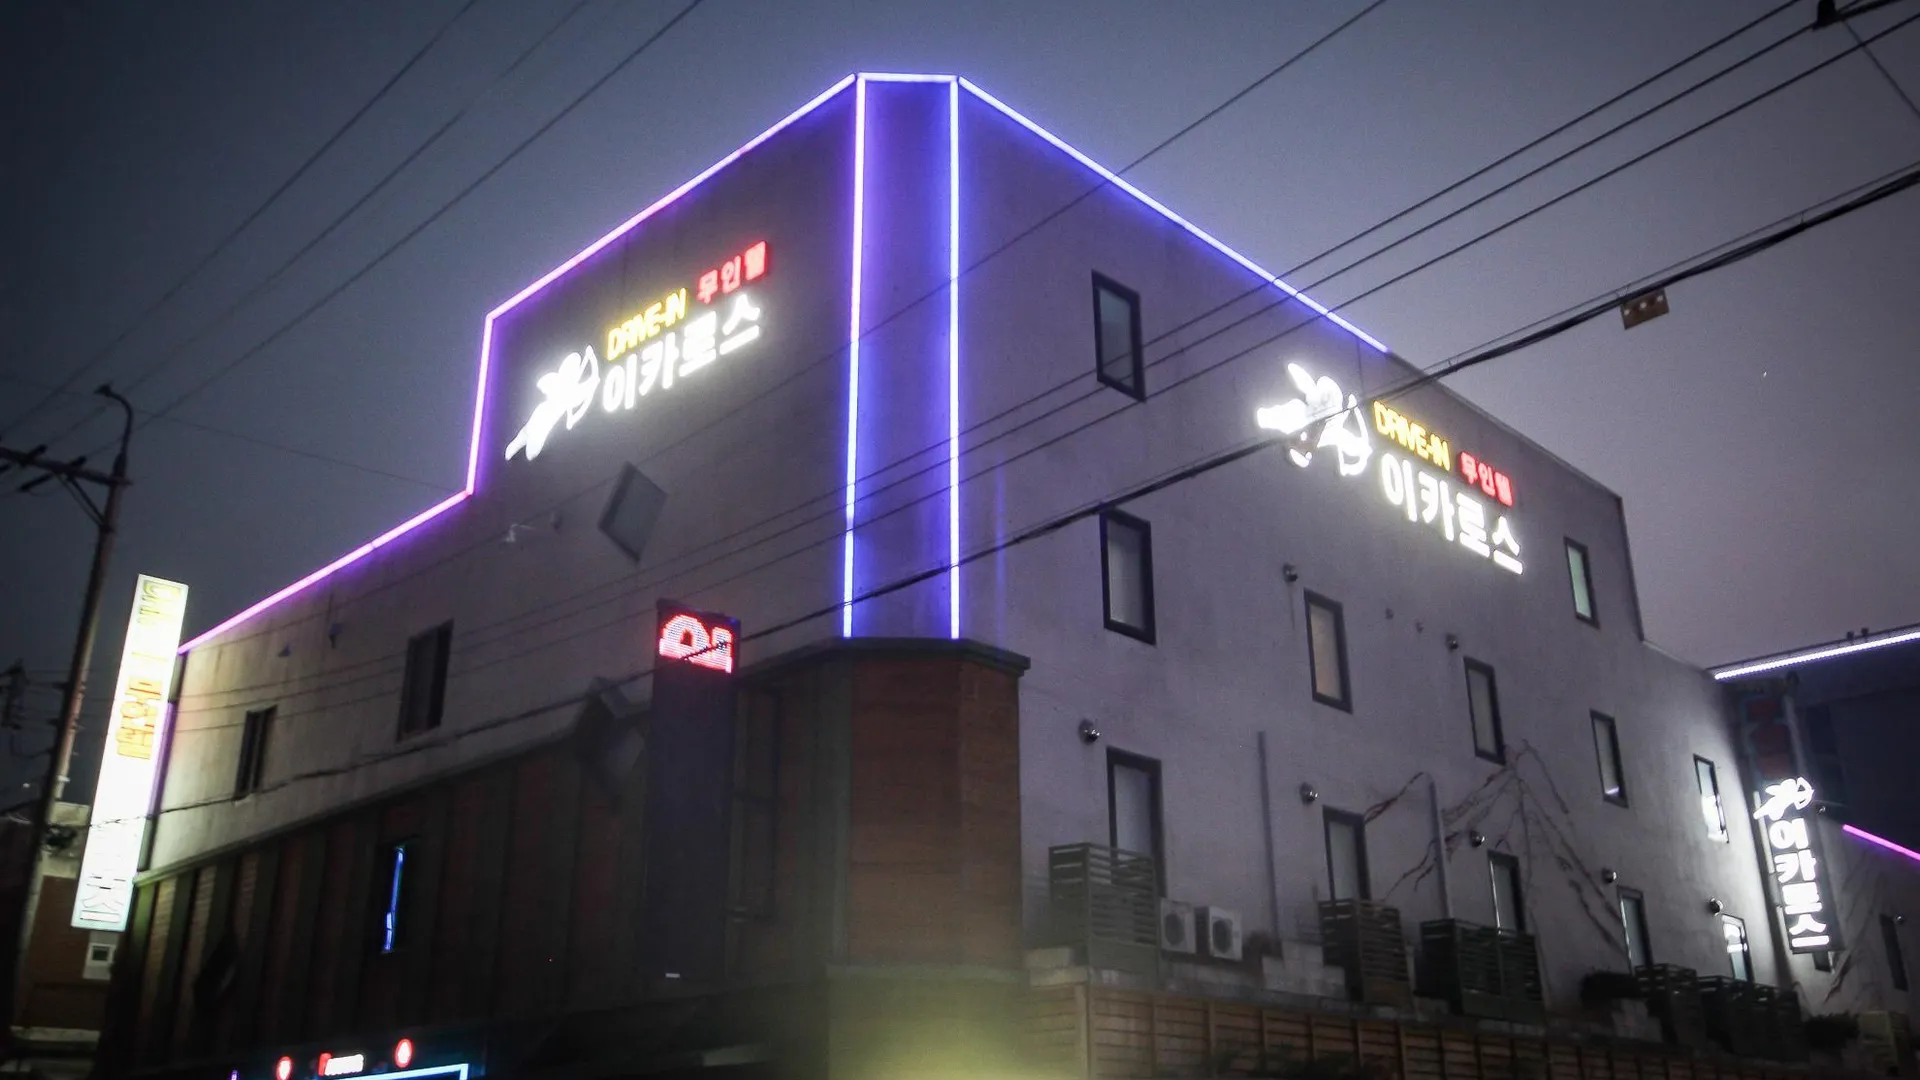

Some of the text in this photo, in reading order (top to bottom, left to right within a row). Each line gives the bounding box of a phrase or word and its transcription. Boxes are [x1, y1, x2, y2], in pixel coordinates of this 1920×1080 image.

[602, 293, 761, 413] 이카로스
[1380, 452, 1524, 575] 이카로스
[1769, 818, 1830, 948] 이카로스
